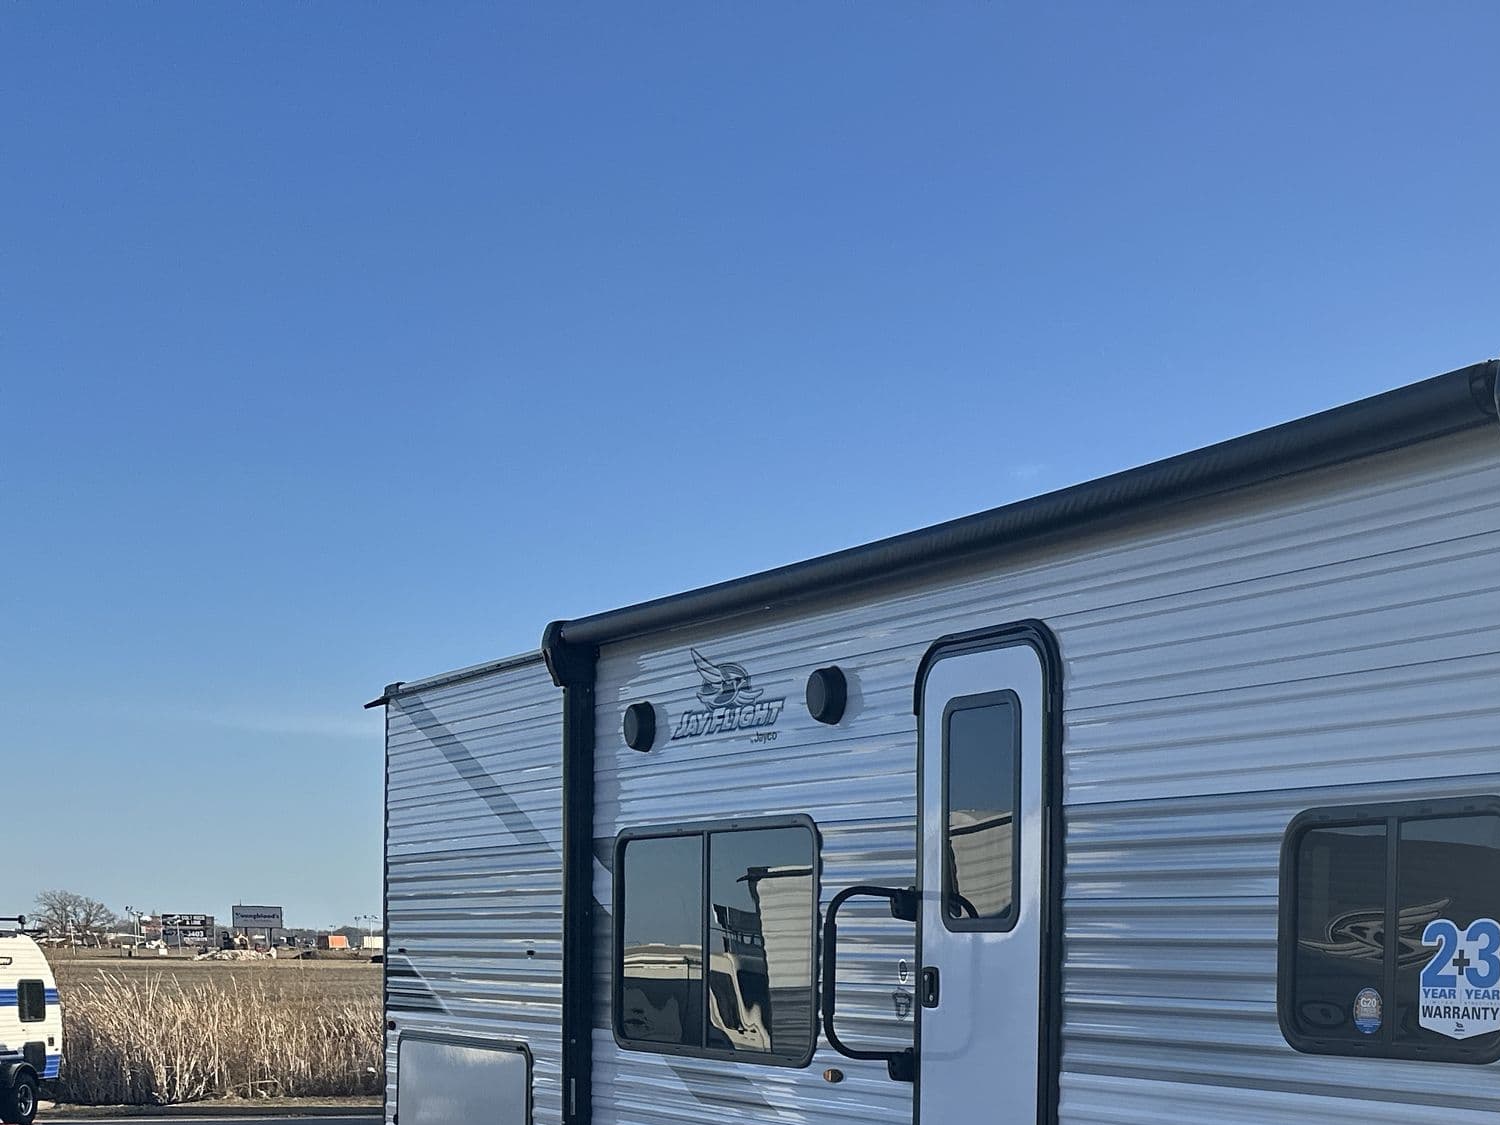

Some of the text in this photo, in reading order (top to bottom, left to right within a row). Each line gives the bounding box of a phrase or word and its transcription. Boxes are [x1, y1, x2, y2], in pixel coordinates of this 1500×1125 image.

[1422, 988, 1500, 1000] YEAR YEAR
[1422, 1005, 1500, 1021] WARRANTY
